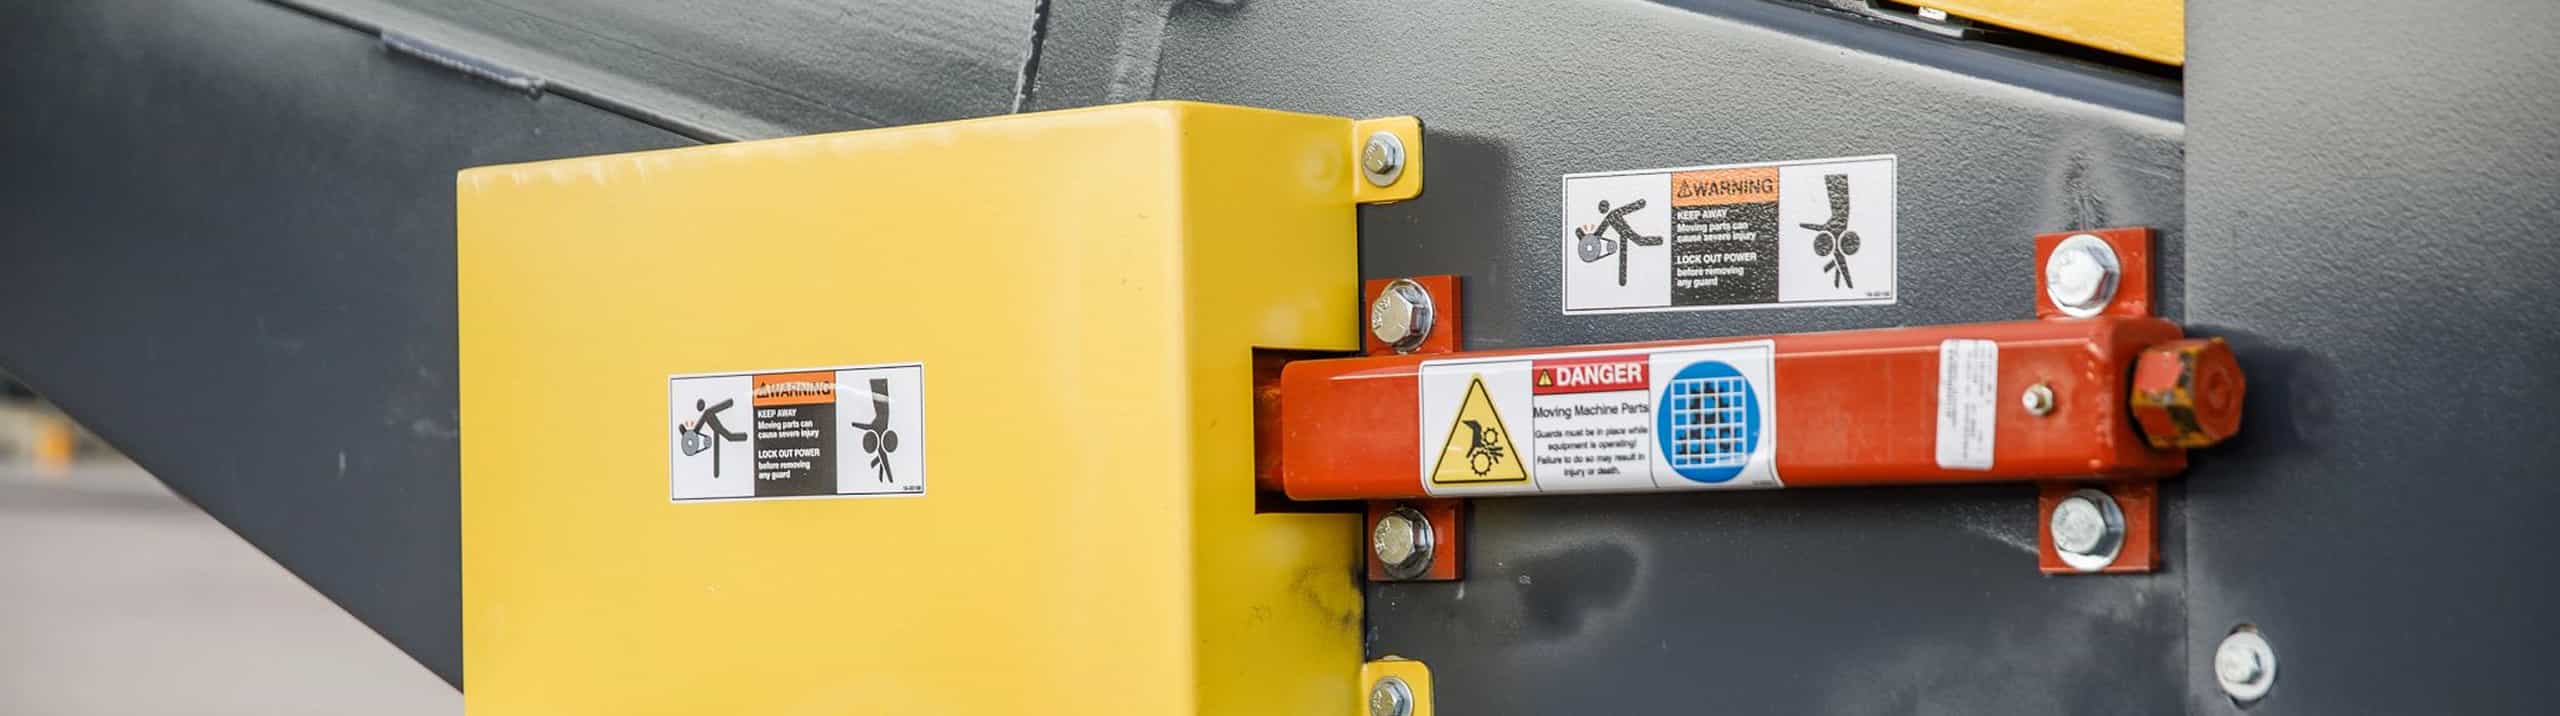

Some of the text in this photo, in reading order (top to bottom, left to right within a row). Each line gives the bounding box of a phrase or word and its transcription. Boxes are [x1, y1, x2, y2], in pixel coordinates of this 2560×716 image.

[1694, 178, 1773, 197] WARNING
[1677, 209, 1728, 220] KEEP AWAY
[1677, 223, 1707, 233] Moving
[1677, 252, 1757, 264] LOCK OUT POWER
[1677, 266, 1744, 277] before removing
[1677, 276, 1718, 288] any guard
[1556, 363, 1642, 386] DANGER
[770, 381, 831, 397] WARNING
[757, 408, 797, 418] KEEP AWAY
[1533, 402, 1650, 420] Moving Machine Parts
[758, 420, 813, 430] Moving parts can
[758, 429, 819, 439] cause severe injury
[1535, 426, 1648, 438] Guards must be in place while
[1548, 441, 1588, 451] equipment
[1590, 441, 1596, 449] is
[758, 448, 820, 458] LOCK OUT POWER
[1537, 456, 1561, 464] Failure
[1574, 455, 1583, 463] do
[1597, 455, 1612, 464] may
[1614, 453, 1636, 461] result
[758, 461, 810, 470] before removing
[758, 470, 790, 480] any guard
[1564, 467, 1584, 477] injury
[1597, 466, 1620, 475] death.
